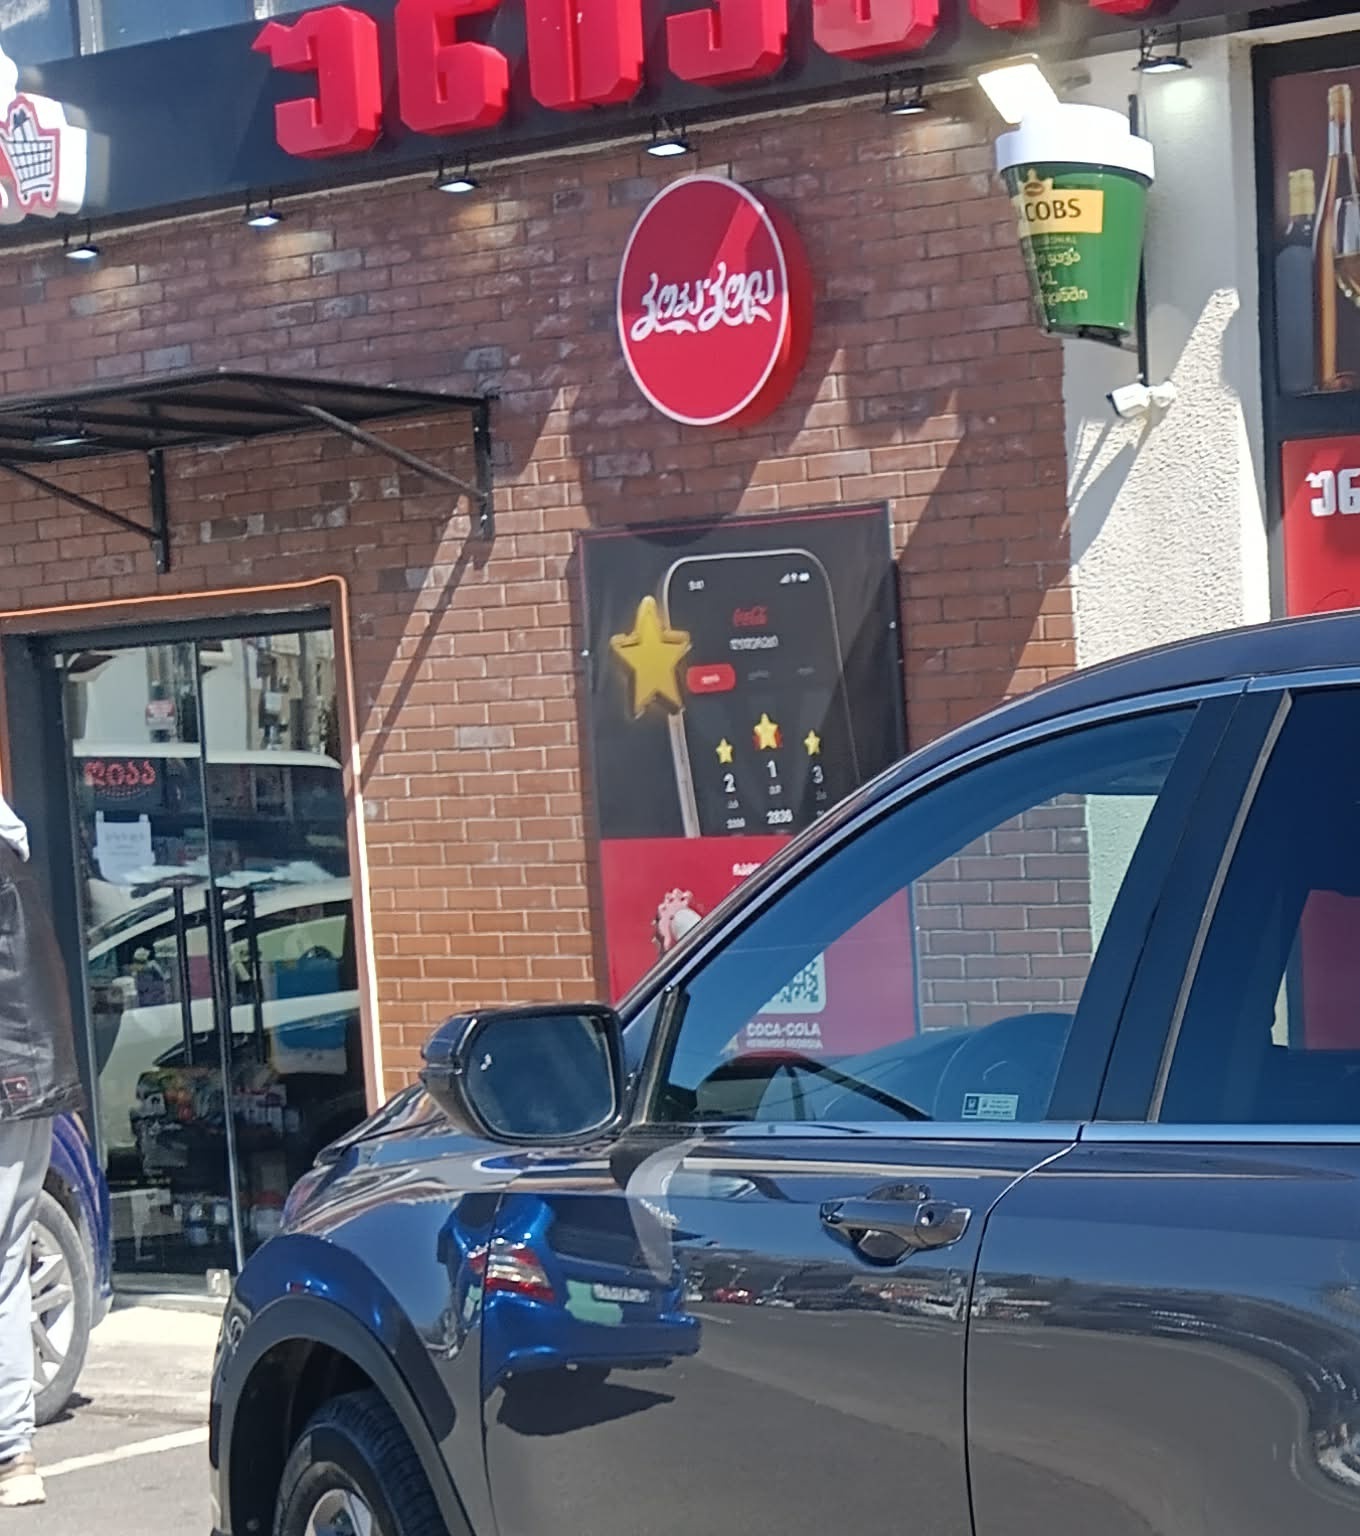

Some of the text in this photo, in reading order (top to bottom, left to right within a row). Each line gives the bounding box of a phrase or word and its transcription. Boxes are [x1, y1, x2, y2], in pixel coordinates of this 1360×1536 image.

[1024, 198, 1082, 222] COBS
[766, 760, 778, 778] 1
[812, 765, 824, 784] 3
[723, 773, 736, 793] 2
[746, 1022, 822, 1037] COCA-COLA
